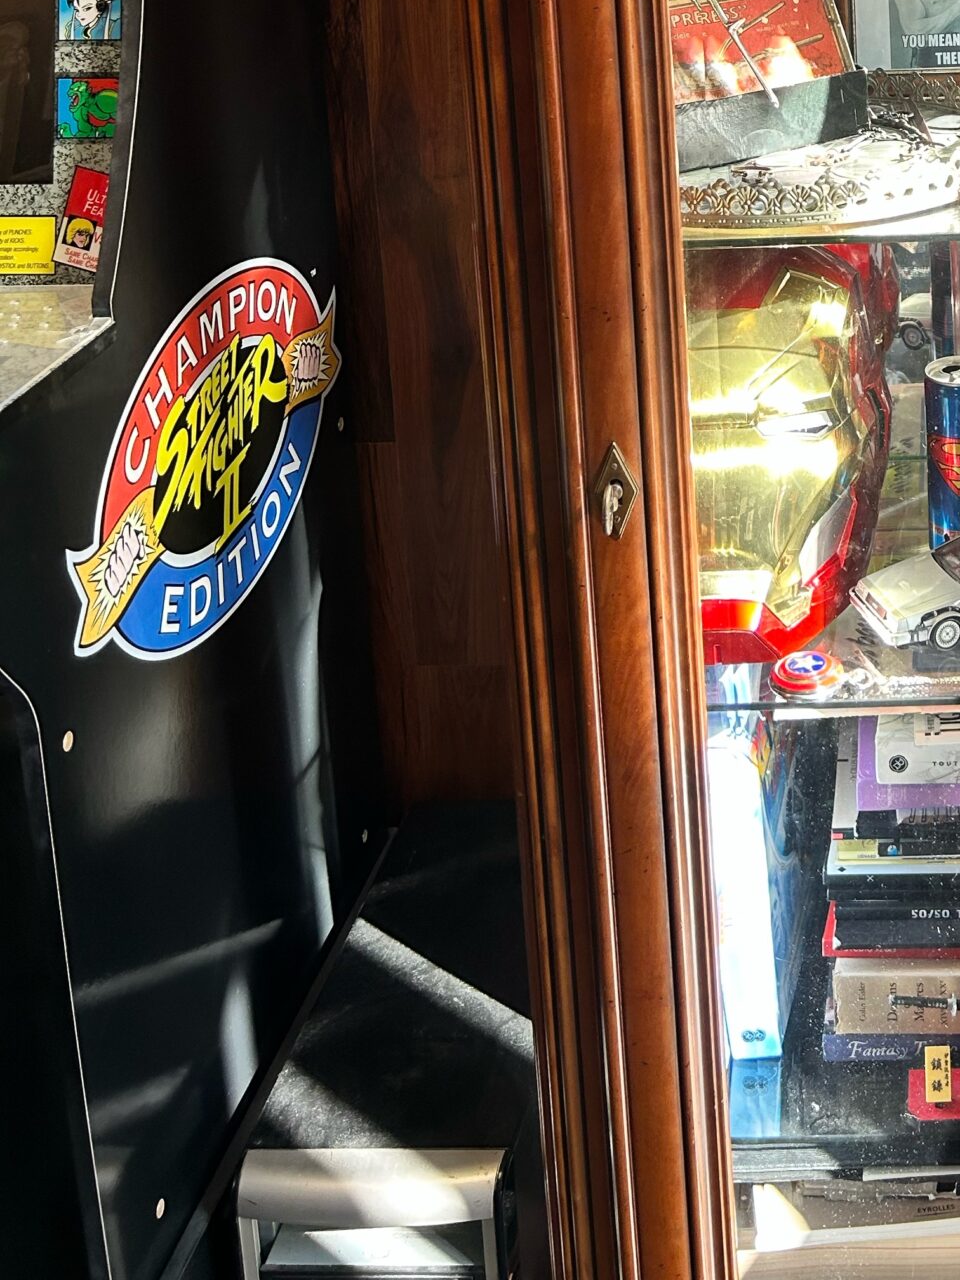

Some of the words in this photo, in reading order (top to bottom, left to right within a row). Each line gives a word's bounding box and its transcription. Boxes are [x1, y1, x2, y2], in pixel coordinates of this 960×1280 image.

[902, 34, 928, 48] YOU
[928, 33, 960, 47] MEAN
[87, 188, 107, 204] ULT
[83, 201, 104, 217] FEA
[124, 281, 298, 485] CHAMPION
[173, 334, 288, 512] FIGHTER
[152, 333, 242, 543] STREET
[213, 442, 253, 555] II
[158, 444, 304, 636] EDITION
[911, 908, 951, 919] 50/50
[848, 1040, 909, 1059] Fantasy
[917, 1203, 956, 1214] EYROLLES
